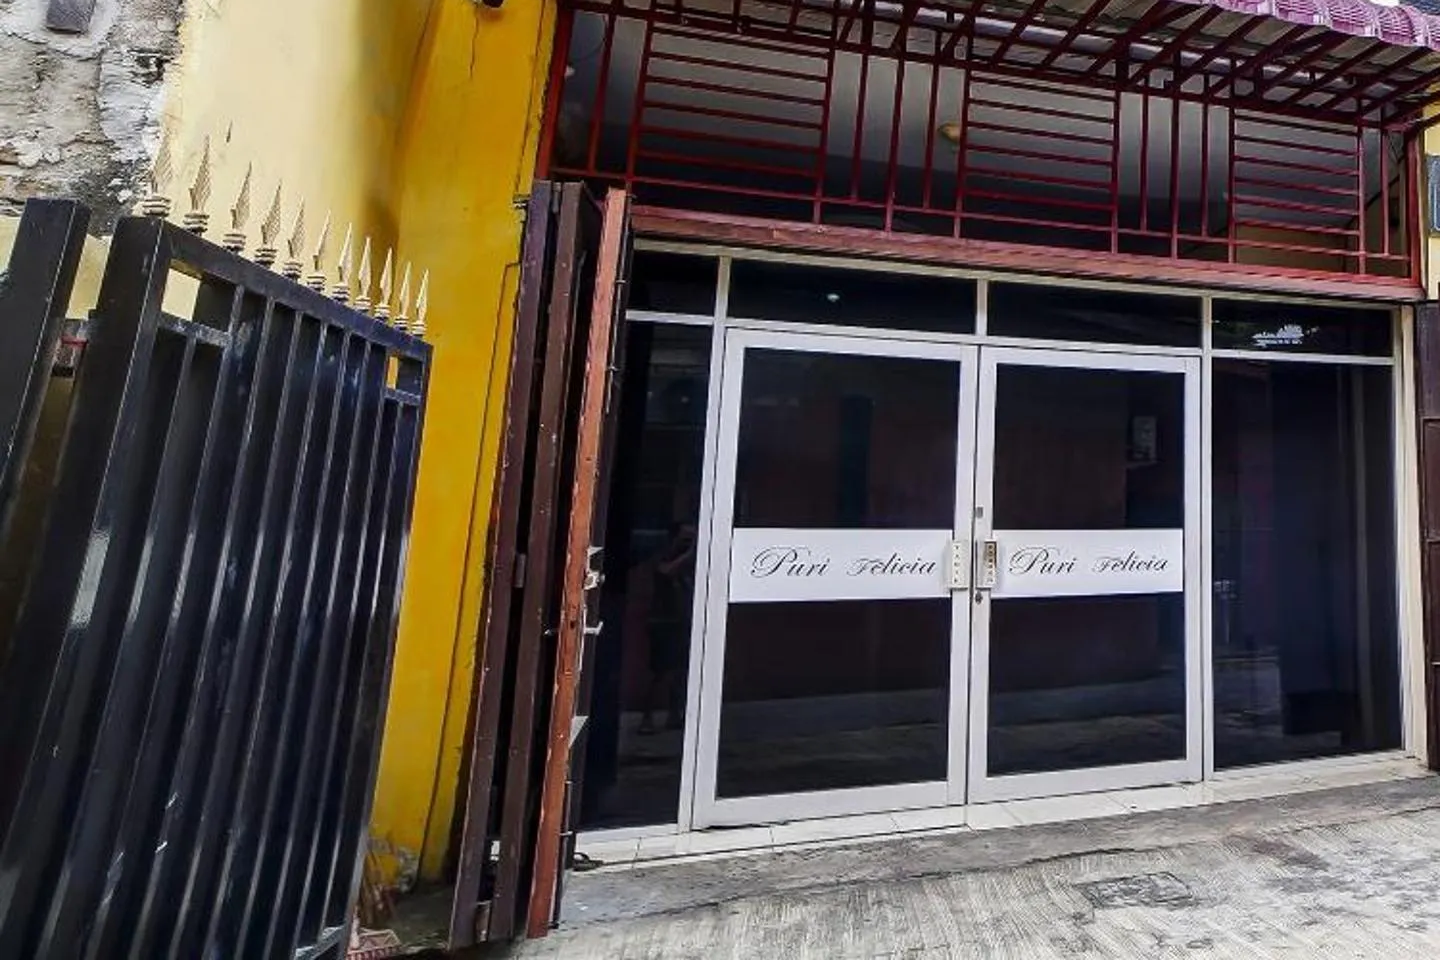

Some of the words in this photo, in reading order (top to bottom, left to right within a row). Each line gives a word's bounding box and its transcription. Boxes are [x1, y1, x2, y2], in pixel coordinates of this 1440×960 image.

[750, 546, 831, 578] Puri
[846, 552, 937, 577] Felicia
[1009, 546, 1077, 576] Puri
[1091, 550, 1169, 574] Felicia
